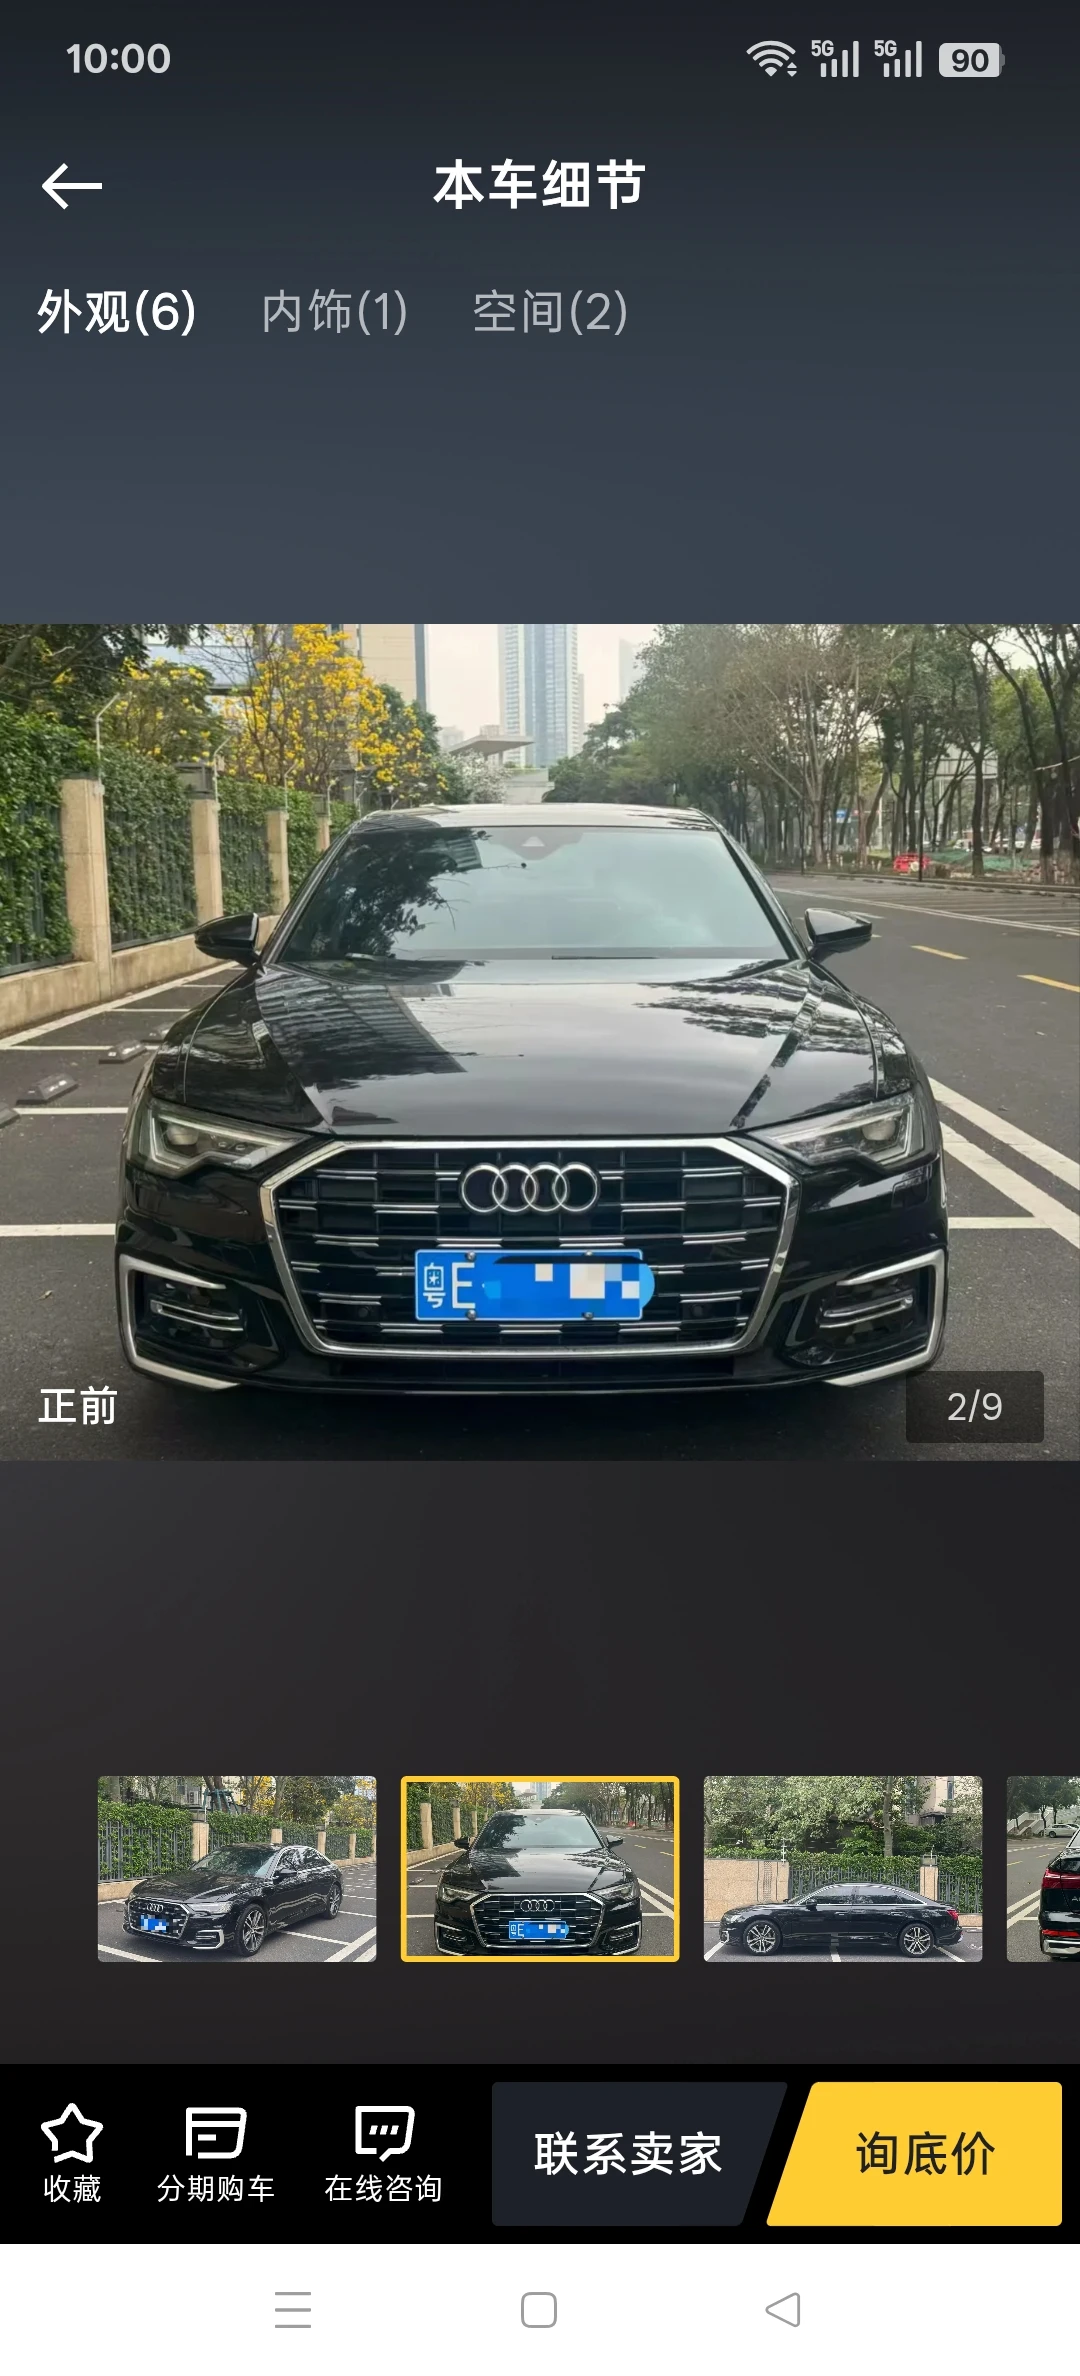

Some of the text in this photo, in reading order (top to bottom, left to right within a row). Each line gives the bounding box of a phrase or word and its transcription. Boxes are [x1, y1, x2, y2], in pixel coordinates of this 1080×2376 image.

[66, 43, 171, 74] 10:00
[811, 39, 835, 57] 5G
[873, 39, 898, 57] 5G
[951, 48, 989, 73] 90
[433, 158, 646, 210] 本车细节
[36, 288, 628, 336] 外观(6) 内饰(1) 空间(2)
[38, 1385, 118, 1425] 正前
[947, 1388, 1003, 1423] 2/9
[535, 2130, 723, 2176] 联系卖家
[856, 2130, 996, 2176] 询底价
[43, 2174, 102, 2204] 收藏
[157, 2174, 275, 2203] 分期购车
[325, 2173, 442, 2203] 在线咨询
